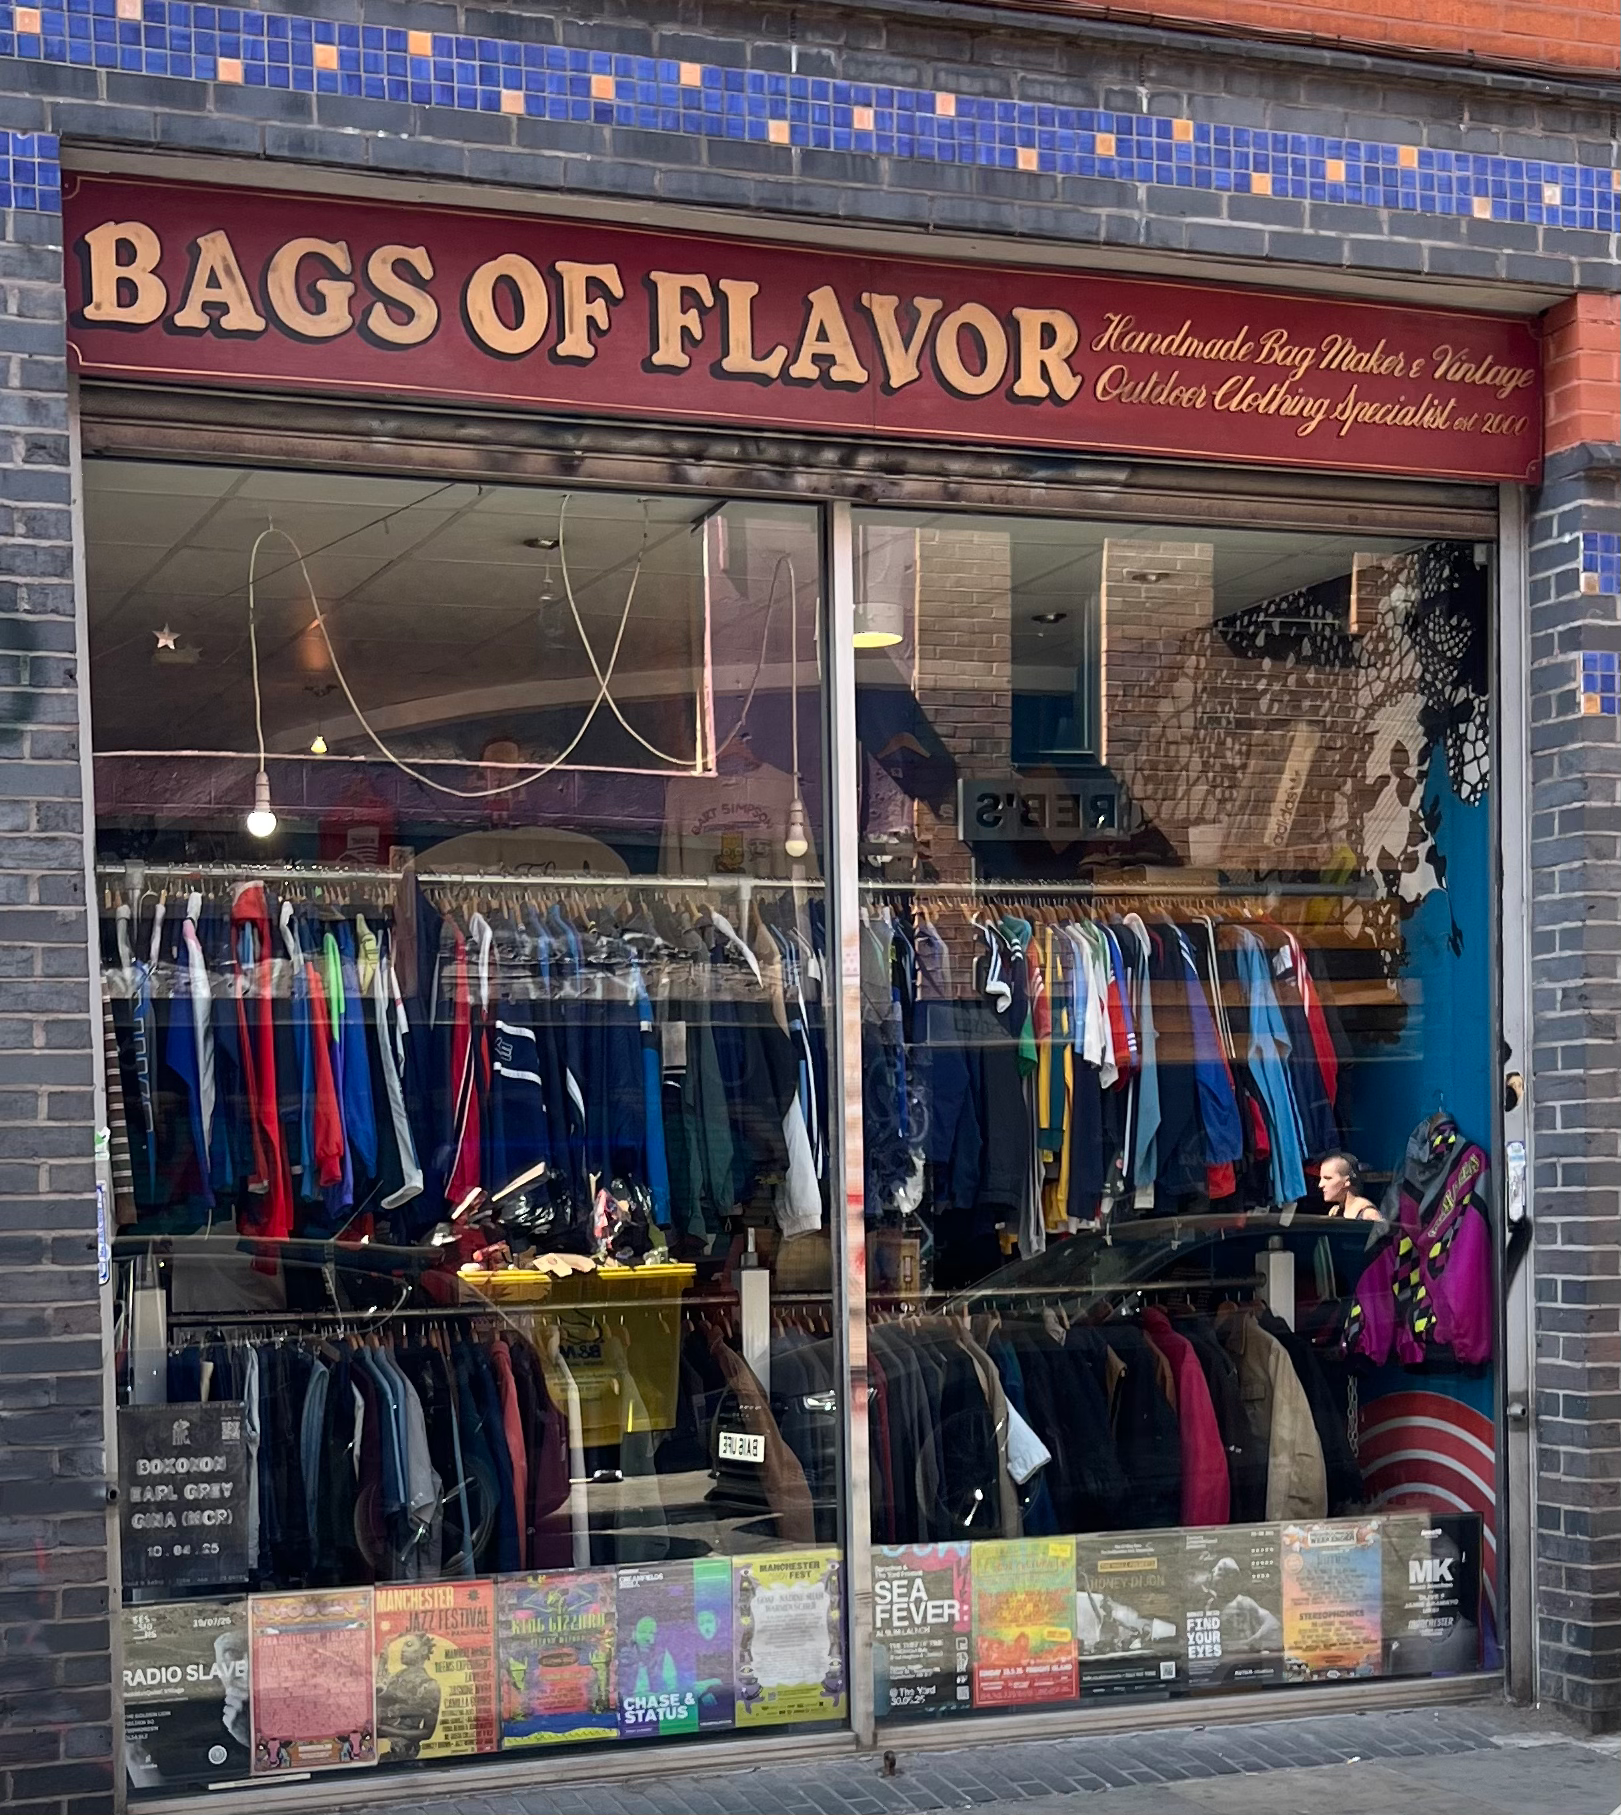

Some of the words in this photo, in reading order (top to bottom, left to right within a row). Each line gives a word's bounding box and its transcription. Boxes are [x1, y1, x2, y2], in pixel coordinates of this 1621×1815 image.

[80, 220, 440, 346] BAGS
[464, 252, 625, 361] OF
[647, 269, 1084, 403] FLAVOR
[1091, 312, 1255, 362] Handmade
[1253, 328, 1318, 382] Bag
[1319, 334, 1406, 379] Maker
[1432, 344, 1535, 400] Vintage
[1095, 364, 1207, 409] Outdoor
[1211, 374, 1331, 437] Clothing
[1329, 383, 1457, 437] Specialist
[1452, 412, 1480, 432] est
[691, 807, 718, 836] BART
[1272, 791, 1299, 846] adidas
[129, 1484, 178, 1503] EARL
[183, 1481, 234, 1501] GREY
[759, 1560, 820, 1573] MANCHESTER
[789, 1570, 812, 1579] FEST
[1409, 1557, 1455, 1585] MK
[376, 1586, 454, 1613] MANCHESTER
[875, 1577, 929, 1604] SEA
[405, 1610, 435, 1633] JAZZ
[438, 1605, 489, 1630] FESTIVAL
[875, 1599, 969, 1629] FEVER:
[1186, 1616, 1221, 1632] FIND
[1299, 1609, 1365, 1621] STEREOPHONICS
[1187, 1630, 1221, 1646] YOUR
[1188, 1644, 1223, 1659] EYES
[122, 1665, 183, 1688] RADIO
[186, 1659, 248, 1683] SLAVE
[623, 1693, 681, 1712] CHASE
[684, 1692, 696, 1705] &
[624, 1705, 689, 1724] STATUS
